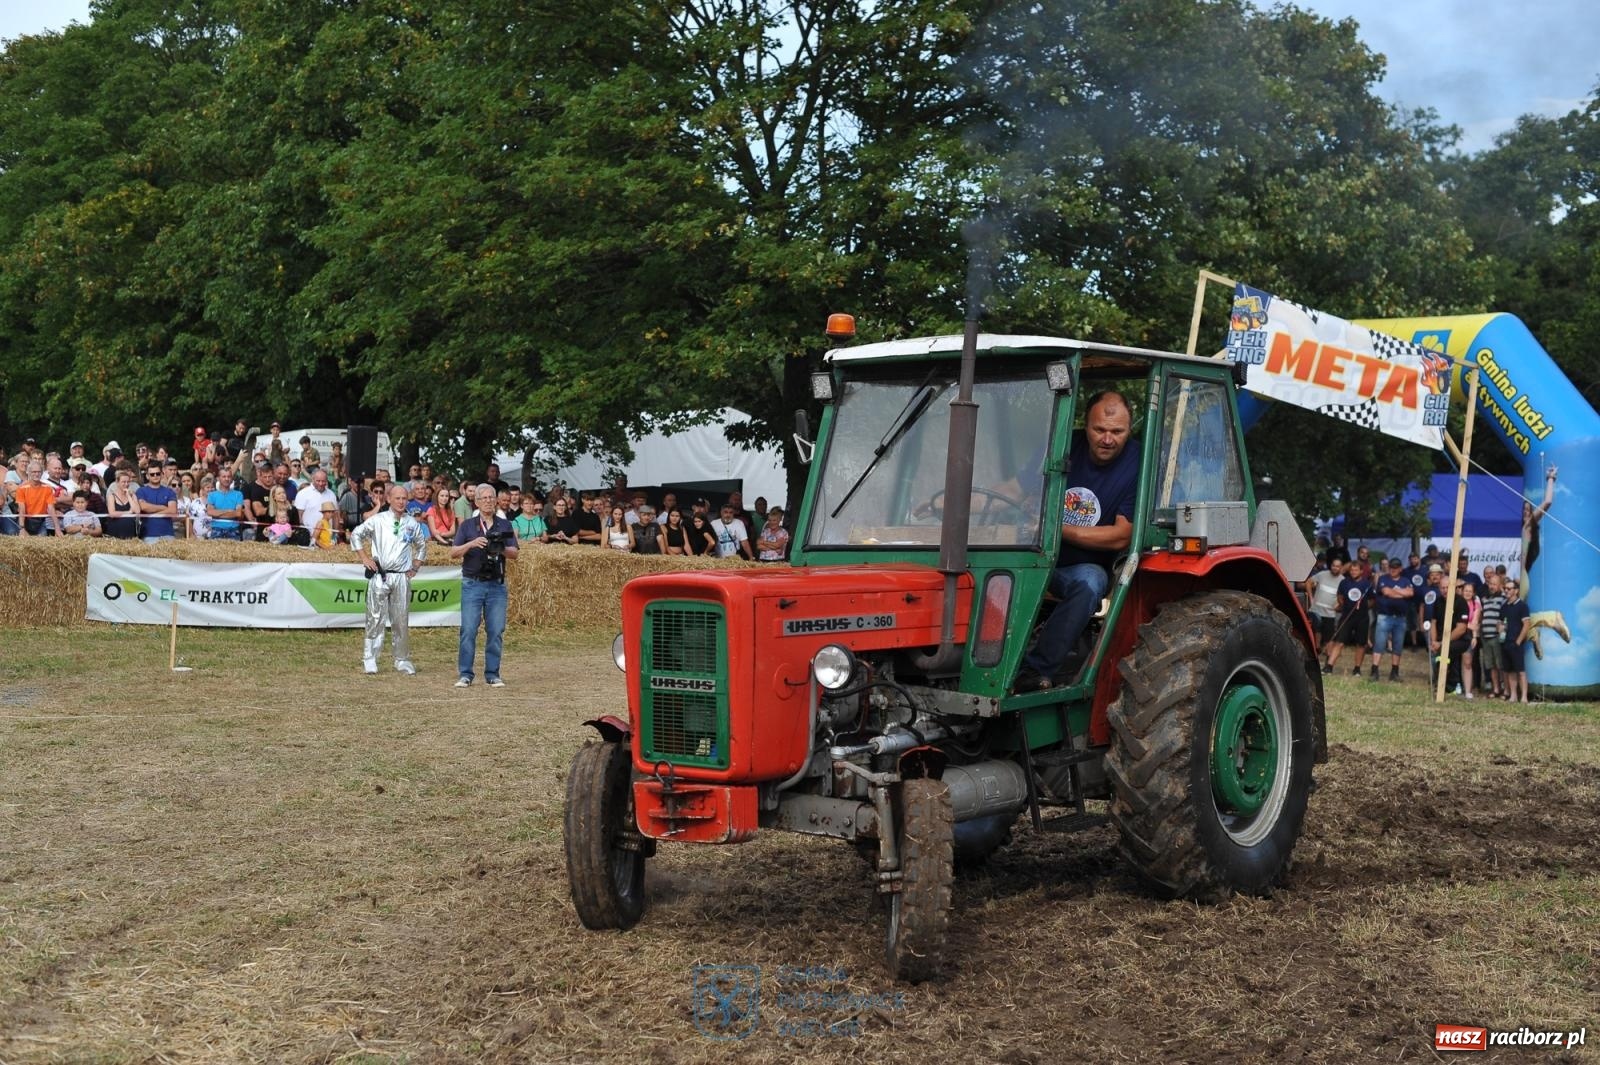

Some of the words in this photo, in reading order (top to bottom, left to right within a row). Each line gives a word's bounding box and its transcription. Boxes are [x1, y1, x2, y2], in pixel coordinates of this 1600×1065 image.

[1265, 332, 1419, 409] META
[1476, 348, 1517, 401] Gmina
[1512, 394, 1554, 440] ludzi
[1465, 371, 1531, 454] atywnych
[160, 588, 268, 604] EL-TRAKTOR
[334, 589, 450, 603] ALTTORY
[787, 618, 851, 632] URSUS
[856, 616, 864, 628] C
[874, 615, 893, 628] 360
[651, 677, 716, 690] URSUS
